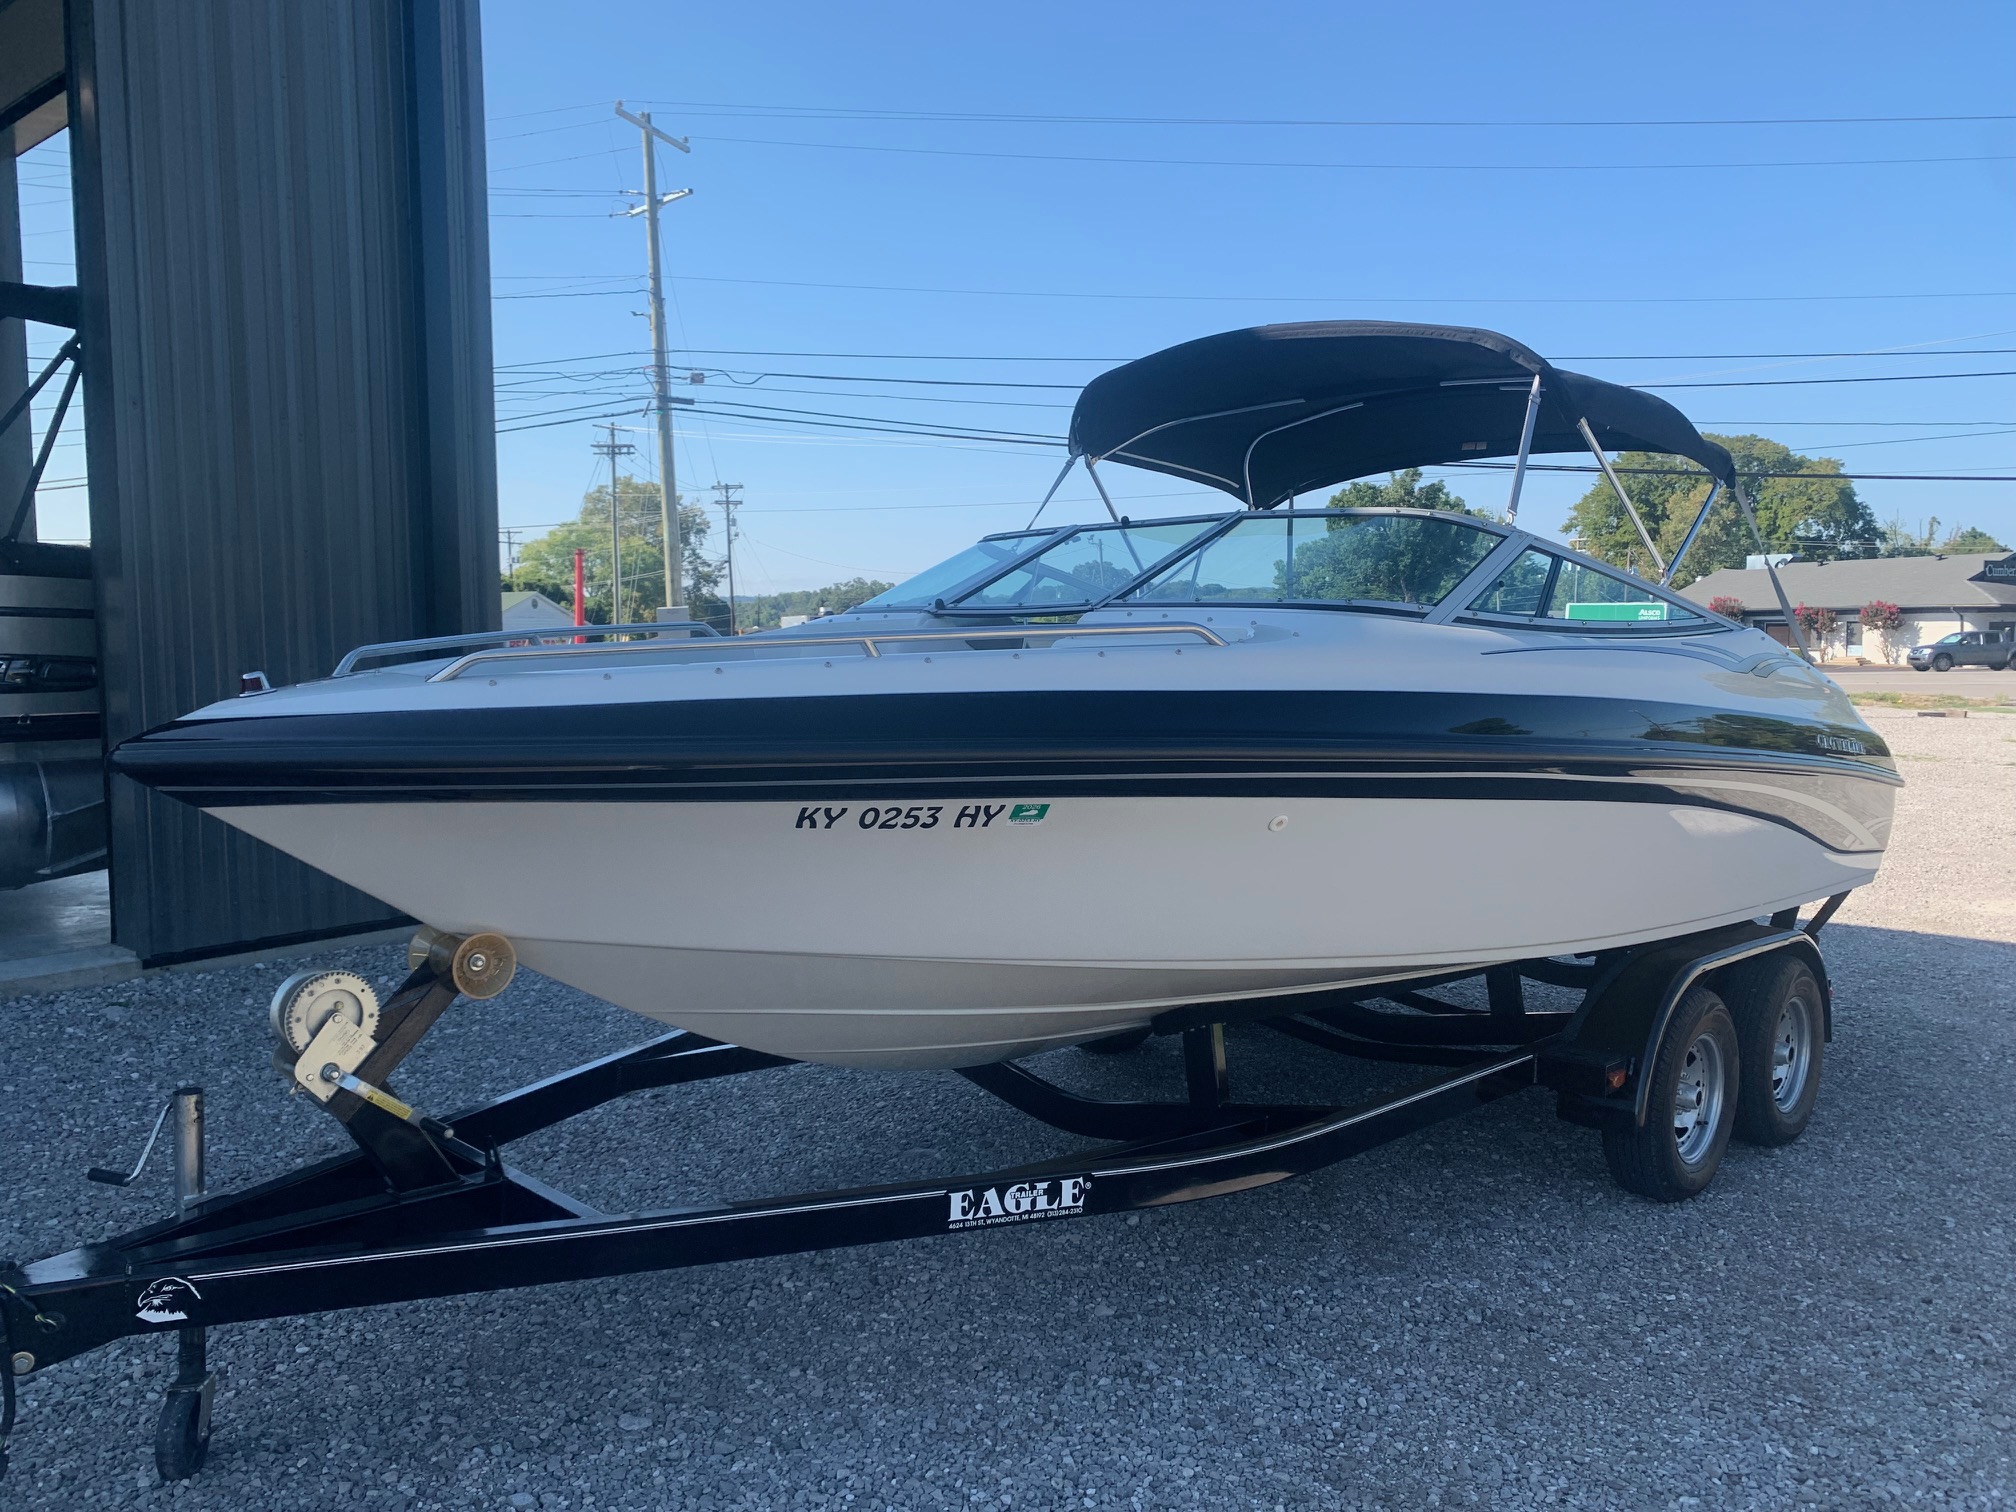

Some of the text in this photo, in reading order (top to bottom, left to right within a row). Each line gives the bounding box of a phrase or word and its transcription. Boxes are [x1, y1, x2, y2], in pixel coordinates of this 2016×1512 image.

[795, 804, 1006, 830] KY 0253 HY
[948, 1176, 1086, 1222] EAGLE
[1010, 1189, 1044, 1199] TRAILER
